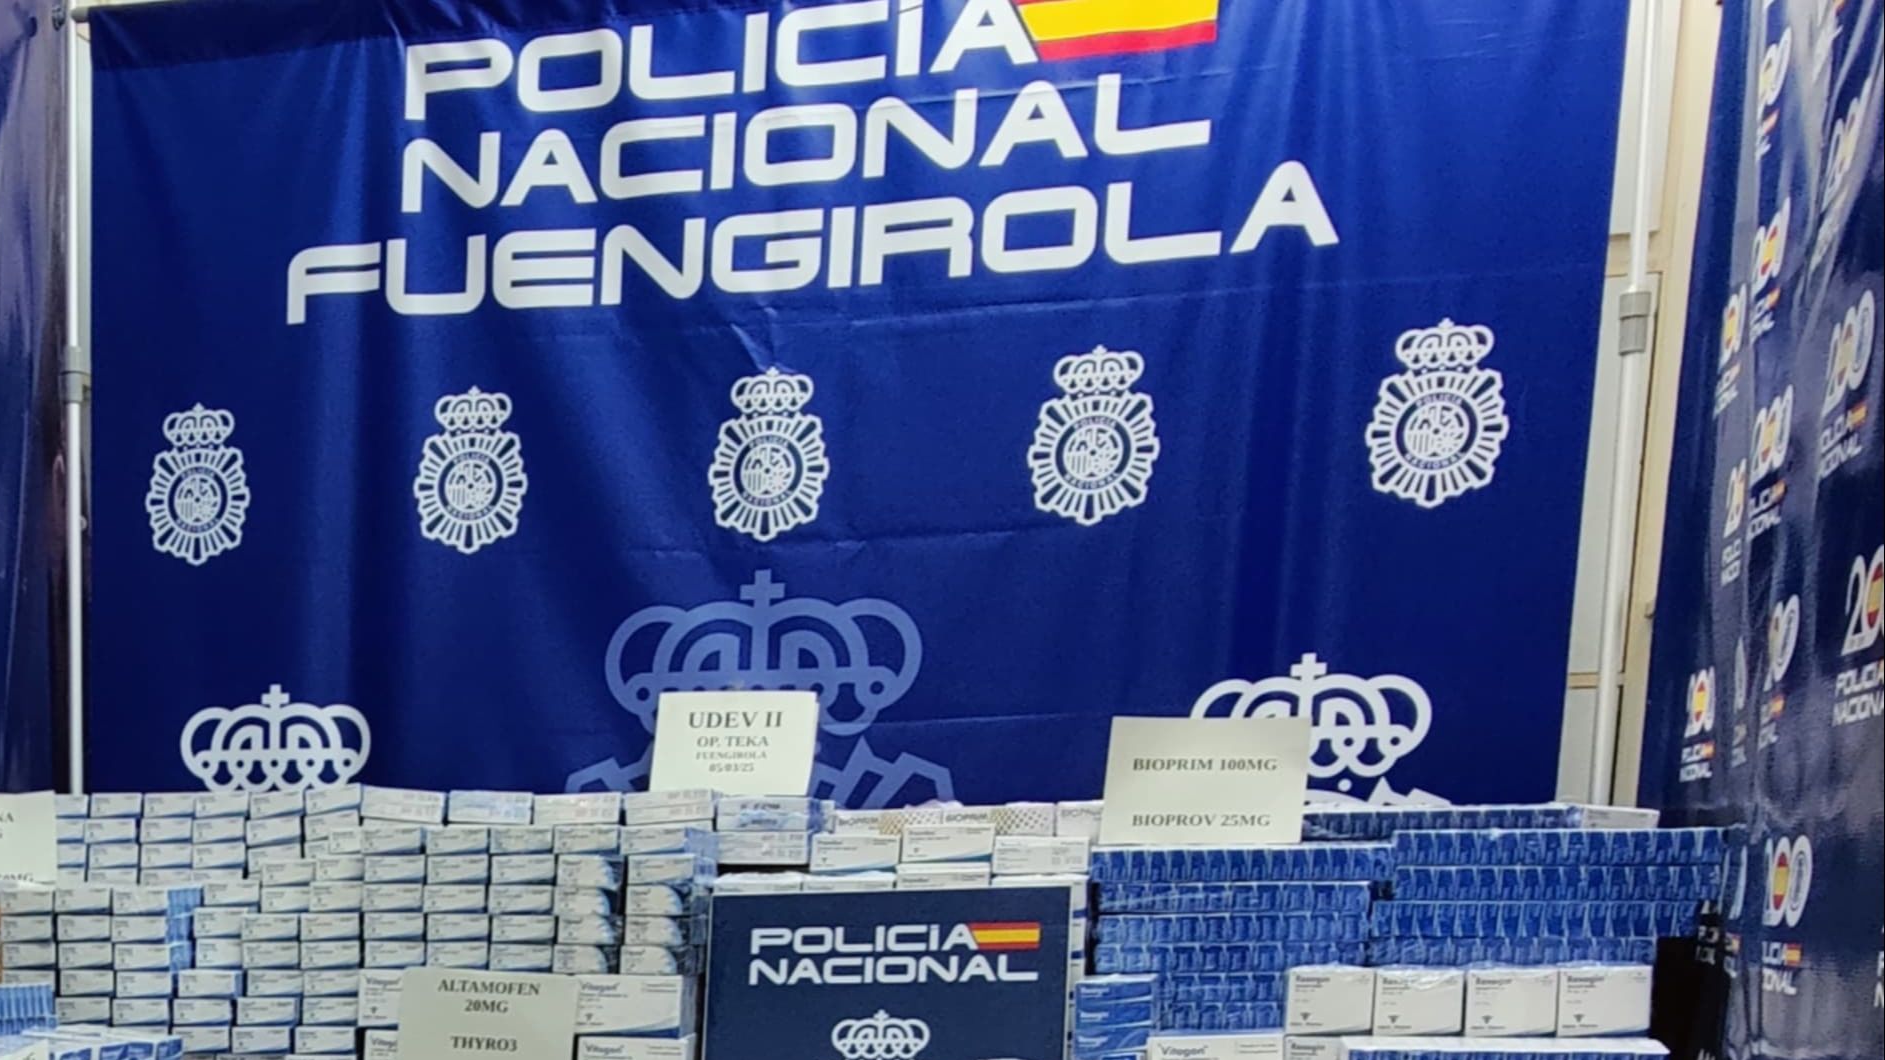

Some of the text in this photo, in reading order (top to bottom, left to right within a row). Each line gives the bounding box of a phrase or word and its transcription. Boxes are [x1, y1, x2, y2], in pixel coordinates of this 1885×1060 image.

[401, 74, 1210, 213] NACIONAL
[287, 161, 1339, 325] FUENGIROLA
[689, 711, 783, 728] UDEV II
[697, 736, 769, 748] OP. TEKA
[1132, 758, 1277, 771] BIOPRIM 100MG
[1132, 814, 1271, 827] BIOPROV 25MG
[748, 954, 1039, 986] NACIONAL
[437, 978, 541, 996] ALTAMOFEN
[464, 999, 509, 1014] 20MG
[450, 1035, 518, 1052] THYRO3
